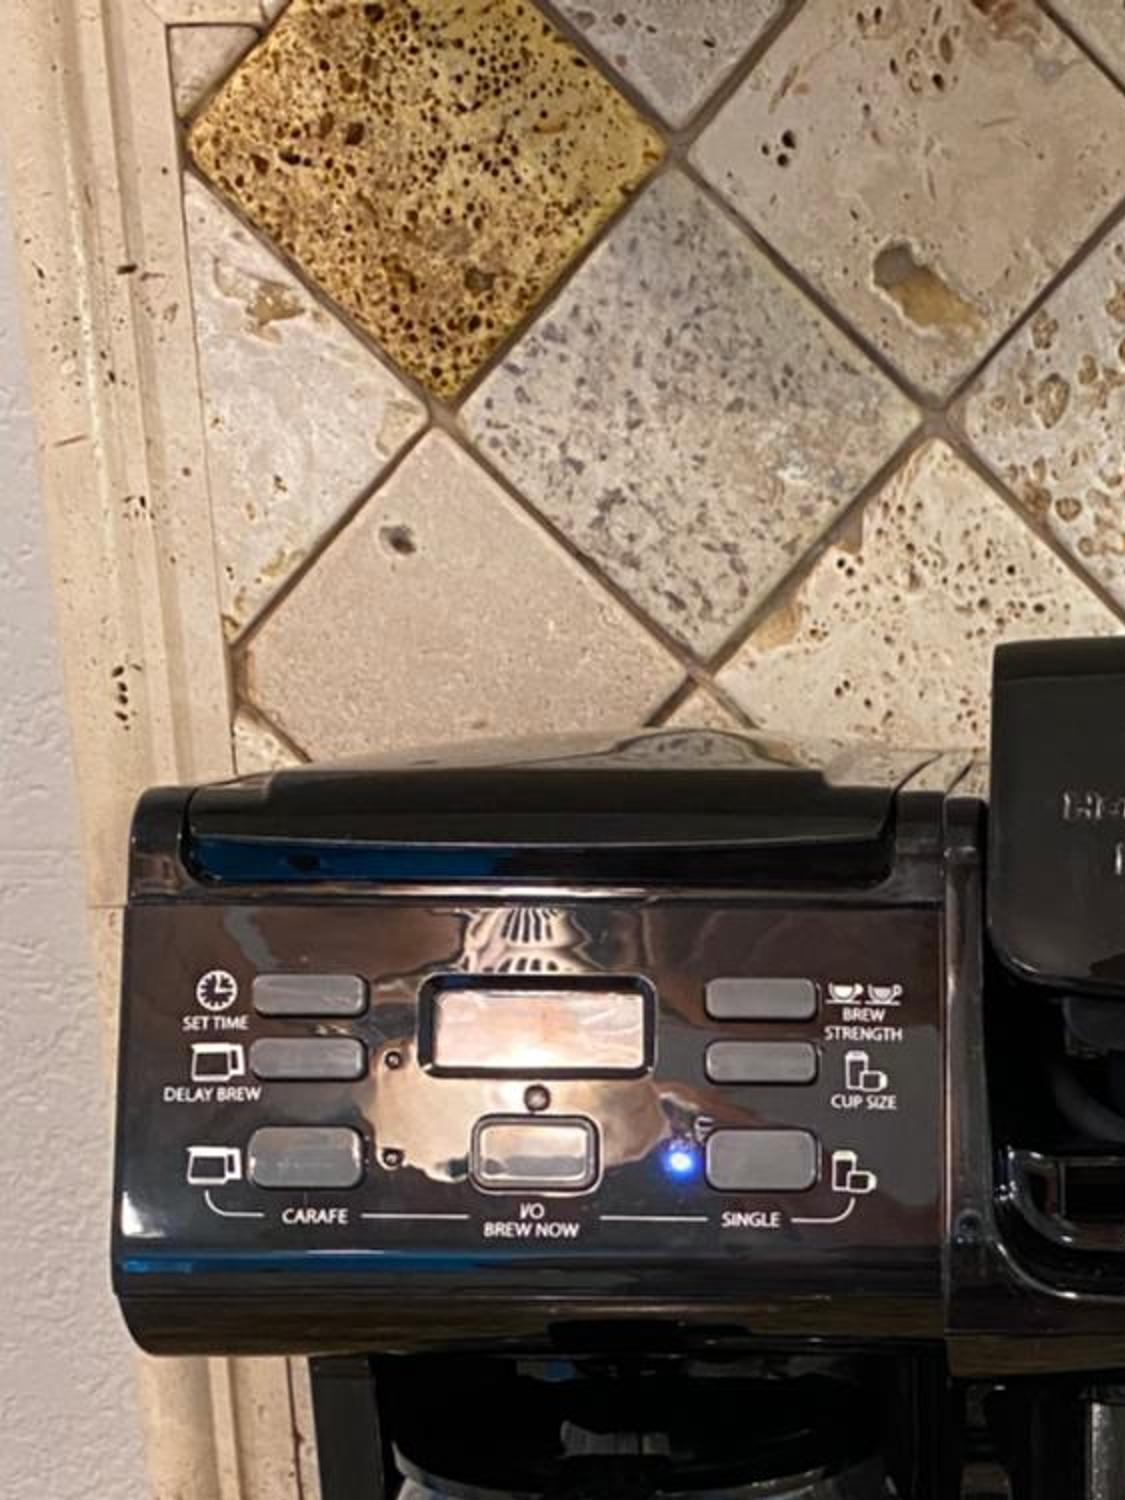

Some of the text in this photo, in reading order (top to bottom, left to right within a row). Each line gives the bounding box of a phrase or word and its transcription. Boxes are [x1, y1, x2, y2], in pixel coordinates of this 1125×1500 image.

[182, 1015, 249, 1031] SET TIME
[842, 1008, 886, 1022] BREW
[824, 1026, 903, 1041] STRENGTH
[163, 1086, 261, 1102] DELAY BREW
[830, 1095, 897, 1109] CUP SIZE
[281, 1208, 349, 1225] CARAFE
[721, 1212, 782, 1228] SINGLE
[483, 1221, 580, 1238] BREW NOW
